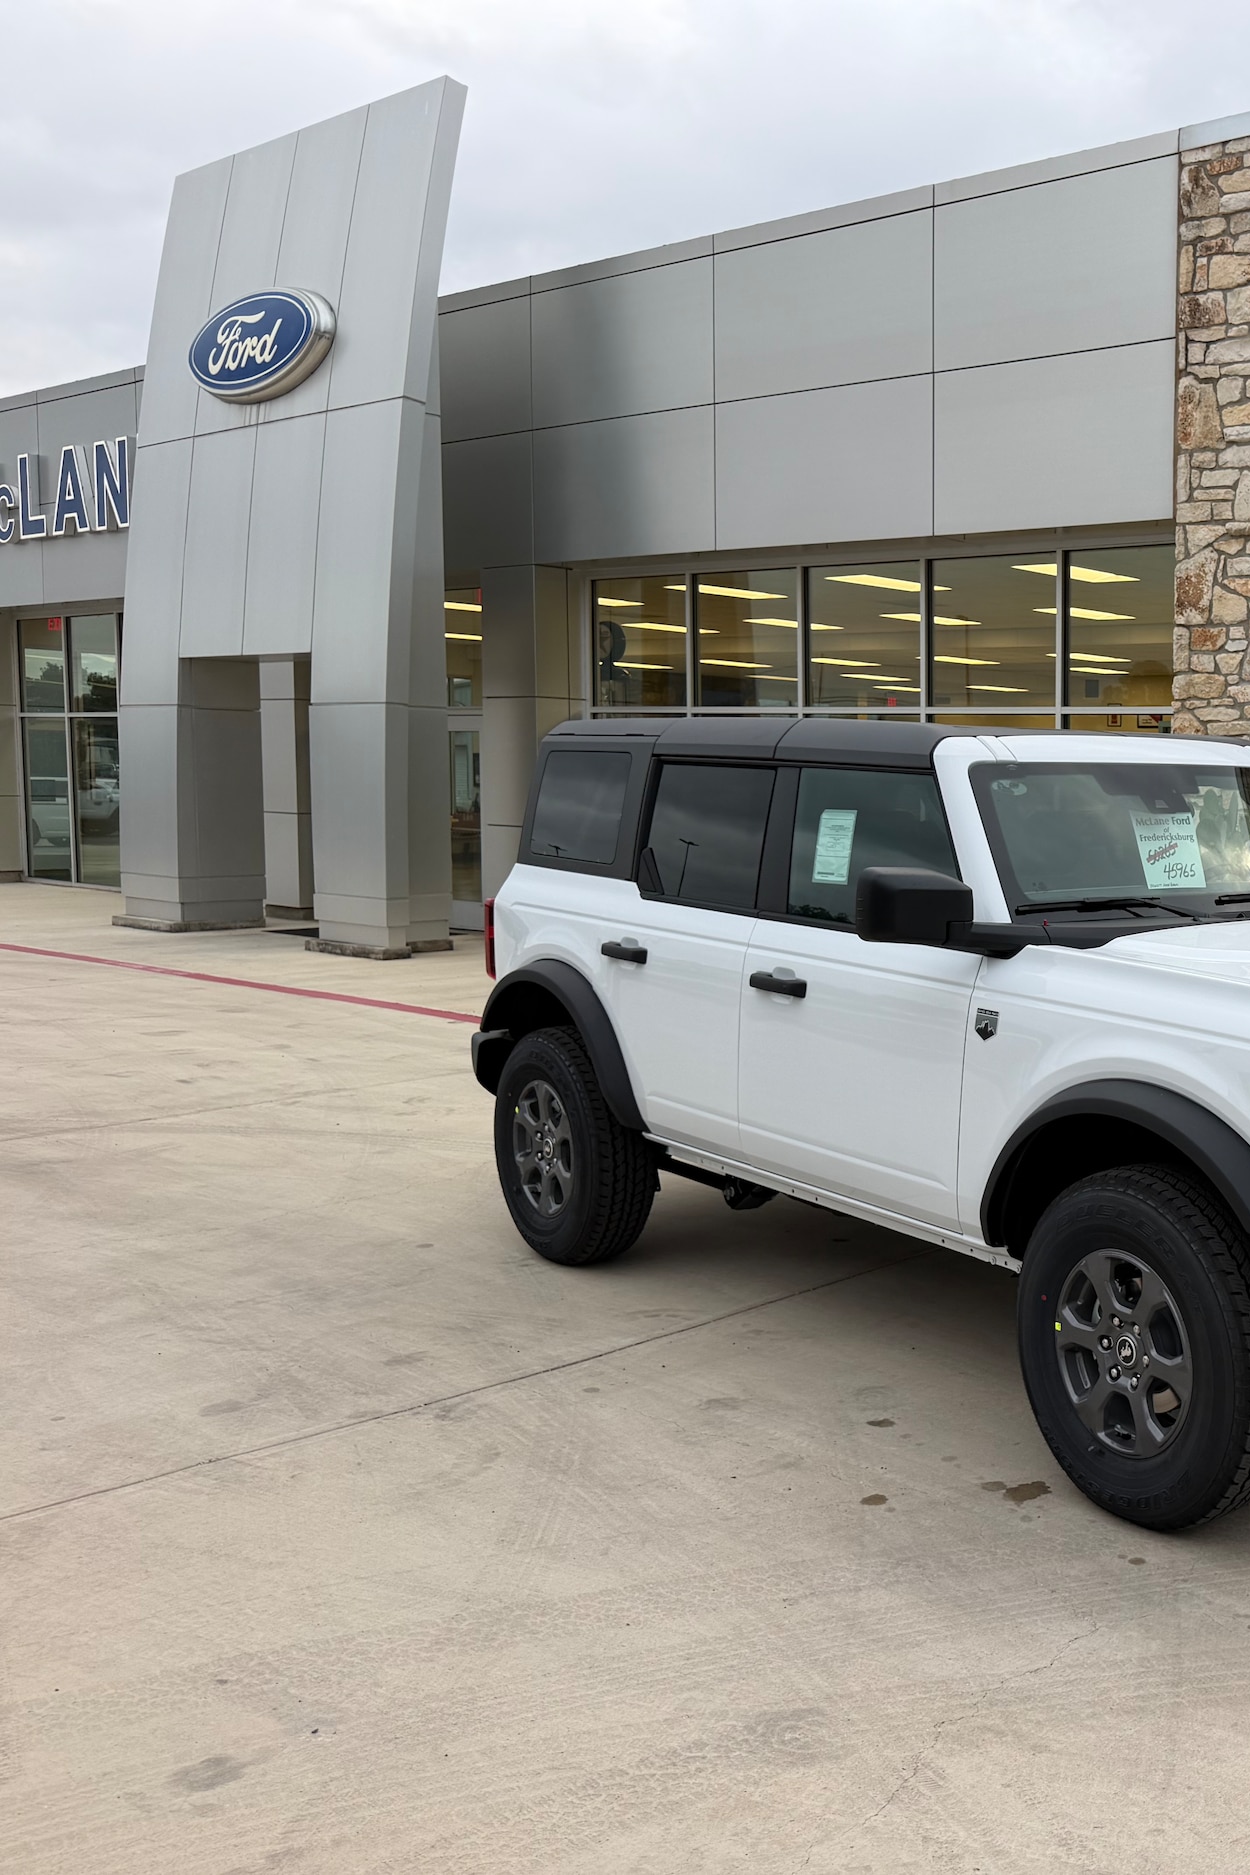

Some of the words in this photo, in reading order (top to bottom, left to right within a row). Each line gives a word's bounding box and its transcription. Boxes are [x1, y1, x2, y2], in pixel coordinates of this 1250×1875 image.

[208, 310, 283, 375] Ford
[1135, 817, 1170, 826] McLane
[1171, 816, 1191, 825] Ford
[1139, 833, 1195, 842] Fredericksburg
[1163, 862, 1196, 880] 45965
